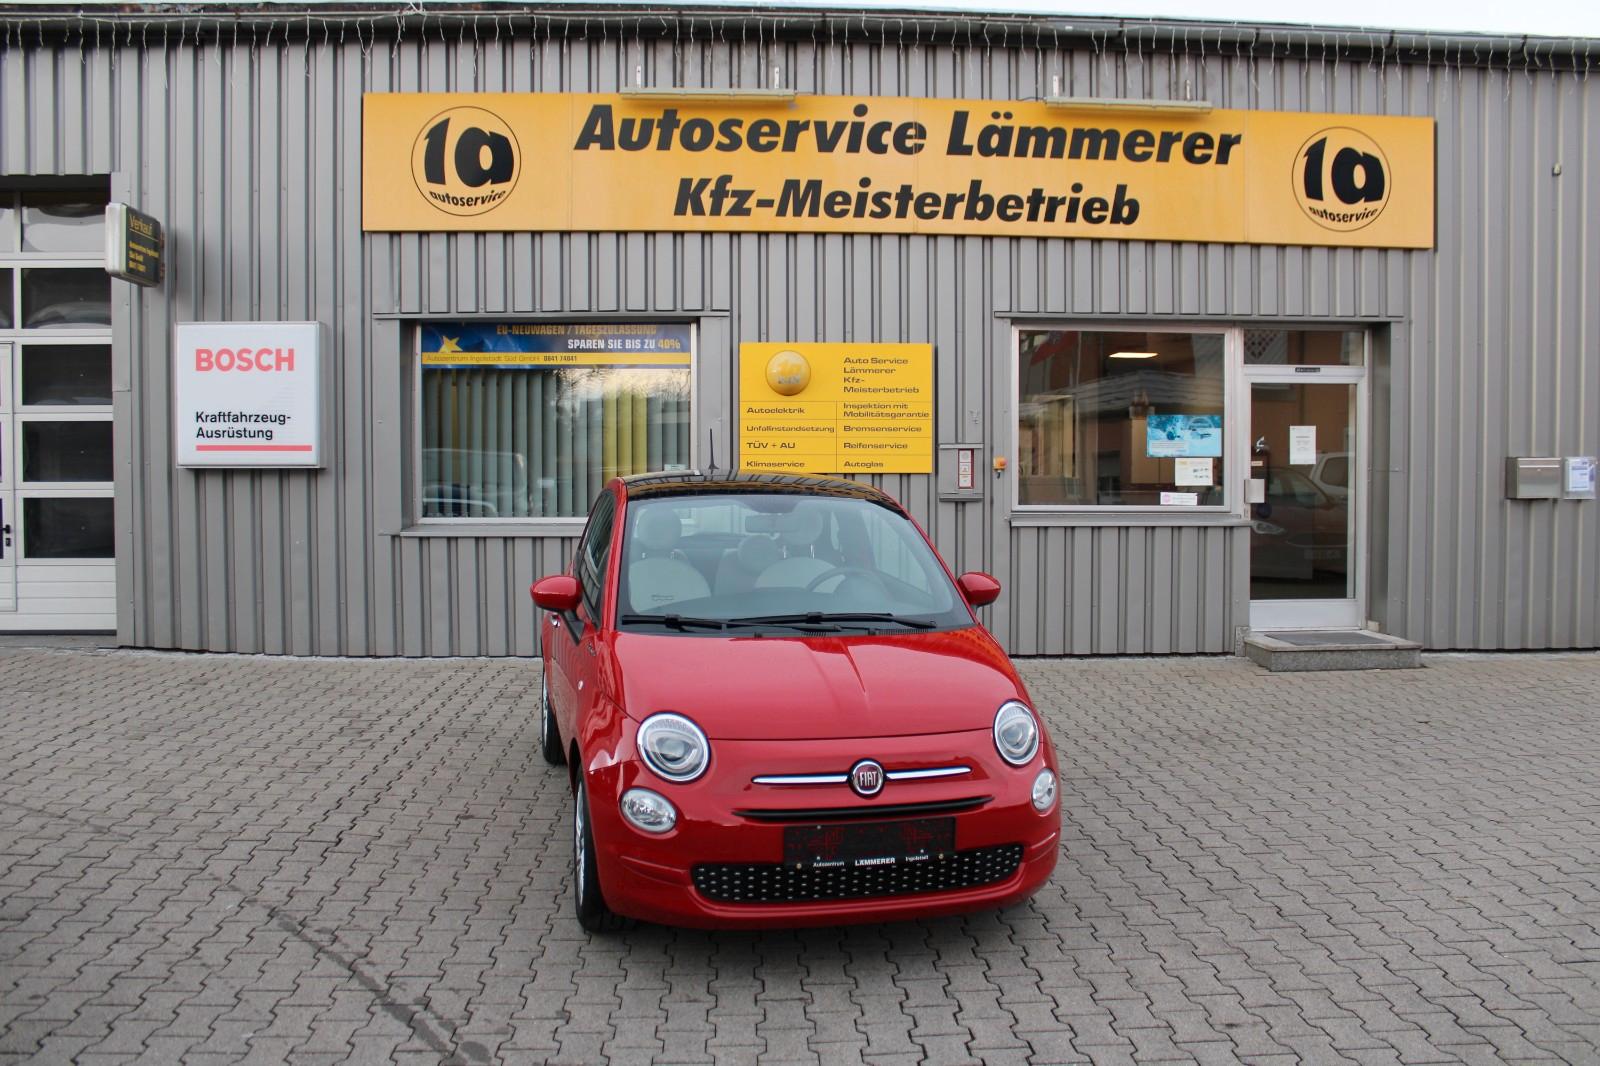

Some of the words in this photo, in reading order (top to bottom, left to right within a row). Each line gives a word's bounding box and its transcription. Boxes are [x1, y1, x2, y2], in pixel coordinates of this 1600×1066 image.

[573, 103, 927, 155] Autoservice
[946, 110, 1242, 165] Lämmerer
[424, 116, 515, 187] 1a
[1303, 136, 1386, 205] 1a
[429, 187, 507, 207] autoservice
[673, 174, 1140, 226] Kfz-Meisterbetrieb
[1308, 204, 1379, 224] autoservice
[567, 339, 605, 349] SPAREN
[607, 339, 623, 349] SIE
[625, 339, 641, 349] BIS
[644, 339, 655, 349] ZU
[658, 339, 681, 349] 40%
[195, 348, 295, 372] BOSCH
[843, 366, 896, 374] Lämmerer
[843, 376, 865, 384] Kfz-
[843, 386, 919, 394] Meisterbetrieb
[195, 411, 292, 425] Kraftfahrzeug-
[843, 410, 929, 419] Mobilitätsgarantie
[196, 426, 273, 441] Ausrüstung
[747, 425, 835, 433] Unfallinstandsetzung
[747, 440, 769, 449] TÜV
[843, 461, 884, 469] Autoglas
[859, 771, 878, 787] FIAT
